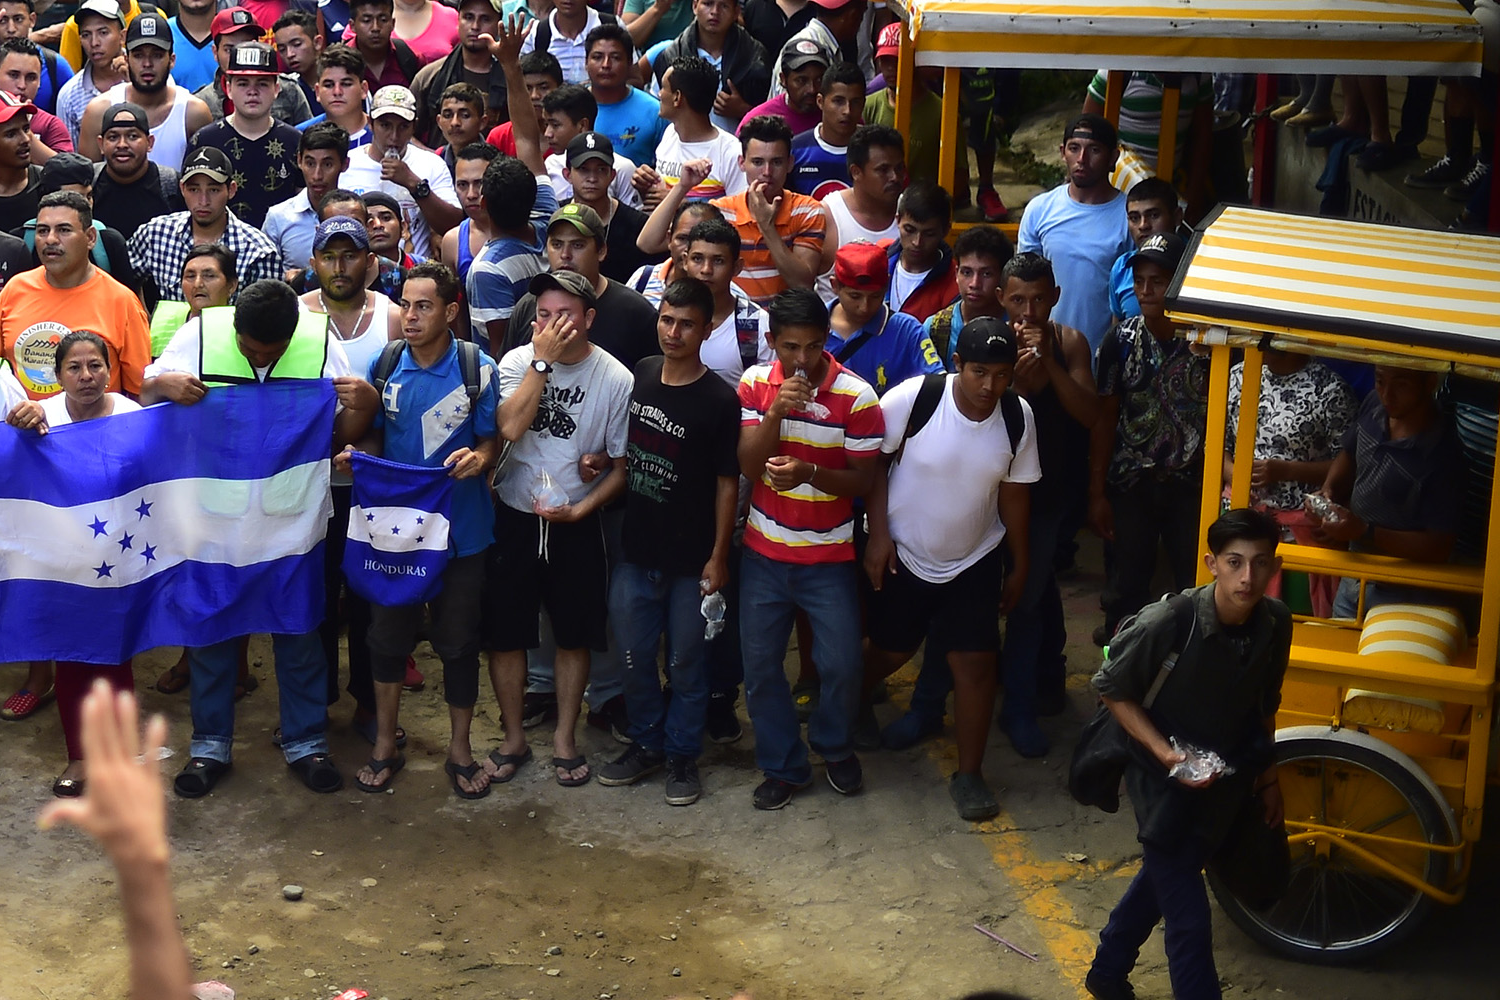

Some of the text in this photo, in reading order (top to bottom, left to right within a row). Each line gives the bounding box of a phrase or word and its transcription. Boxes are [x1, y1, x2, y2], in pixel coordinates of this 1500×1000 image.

[16, 322, 54, 346] FINISHER
[24, 348, 56, 359] Danang
[31, 383, 54, 392] 2013
[383, 382, 402, 412] H
[640, 405, 669, 428] STRAUSS
[665, 421, 673, 433] &
[641, 462, 679, 482] CLOTHING
[364, 559, 427, 577] HONDURAS
